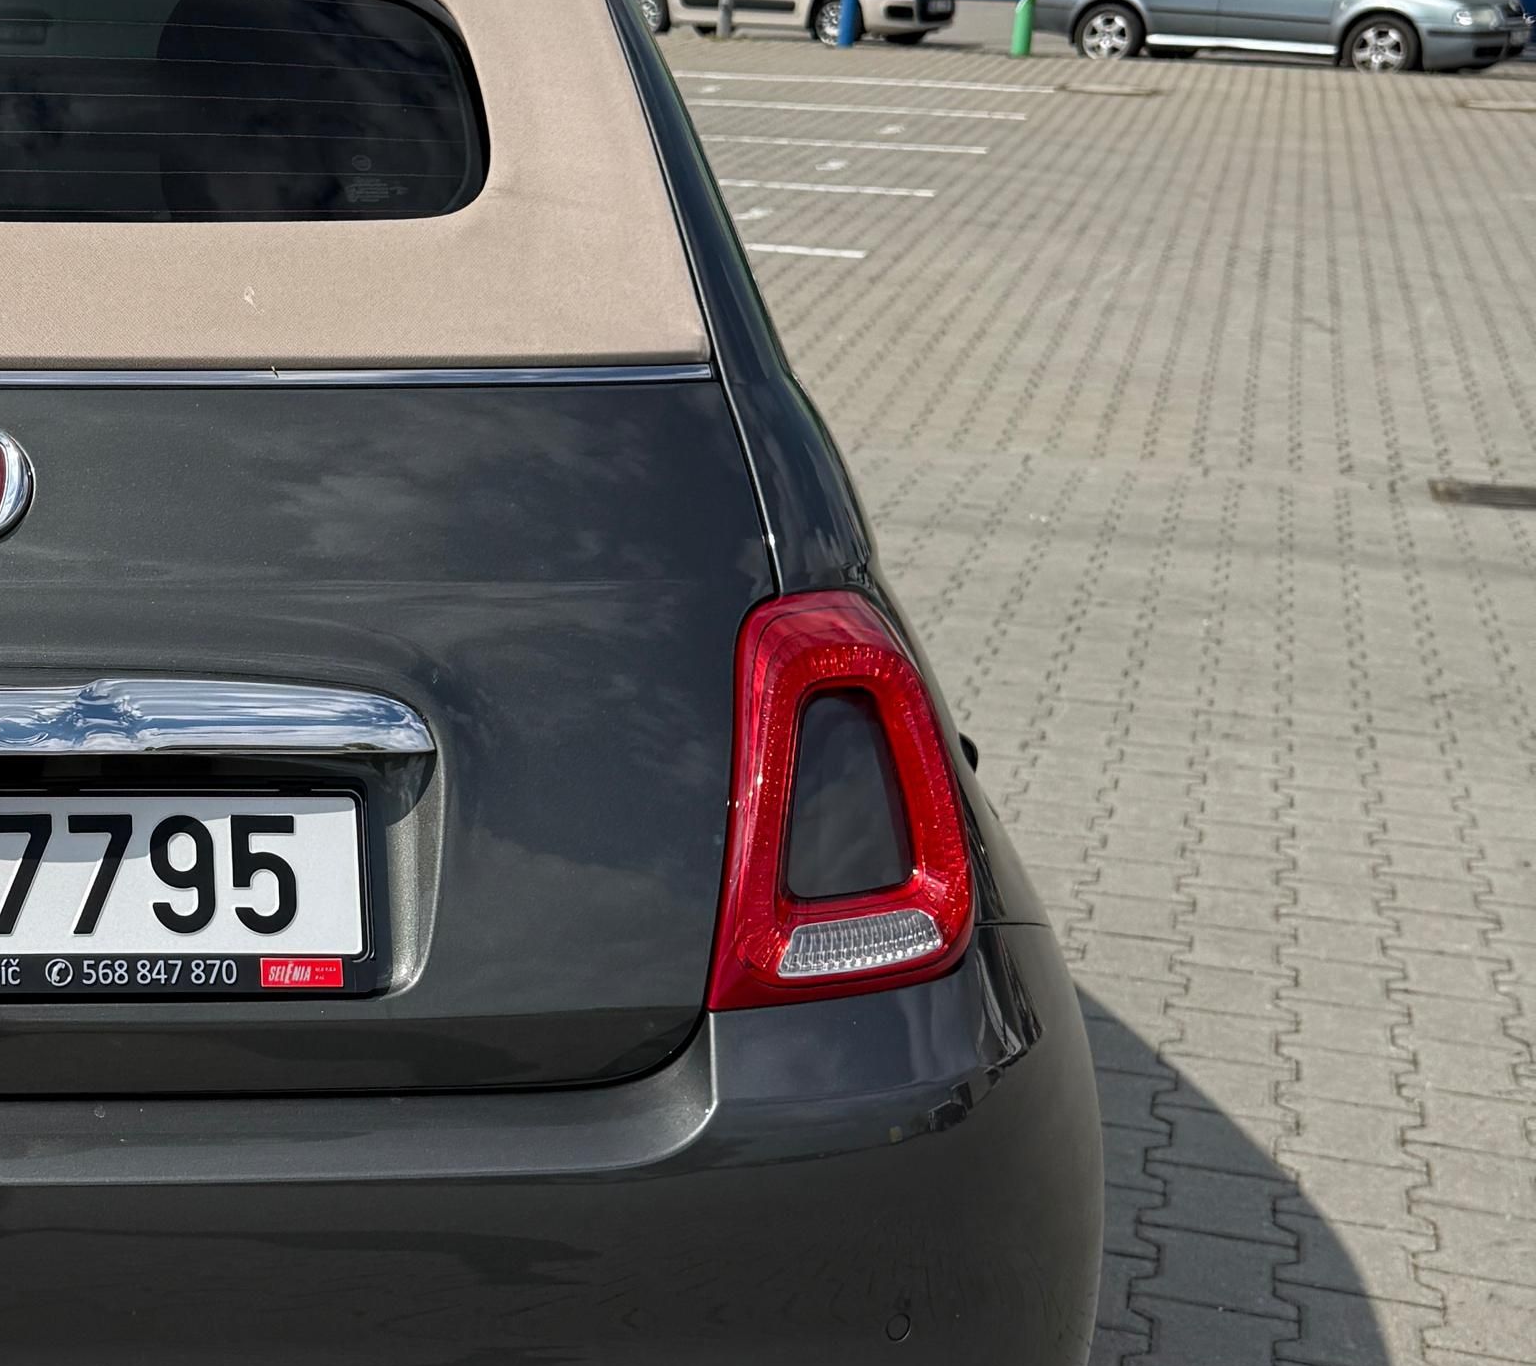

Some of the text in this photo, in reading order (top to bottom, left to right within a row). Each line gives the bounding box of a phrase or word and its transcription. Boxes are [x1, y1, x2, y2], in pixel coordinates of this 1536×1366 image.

[82, 959, 129, 985] 568
[136, 959, 182, 985] 847
[190, 959, 237, 985] 870
